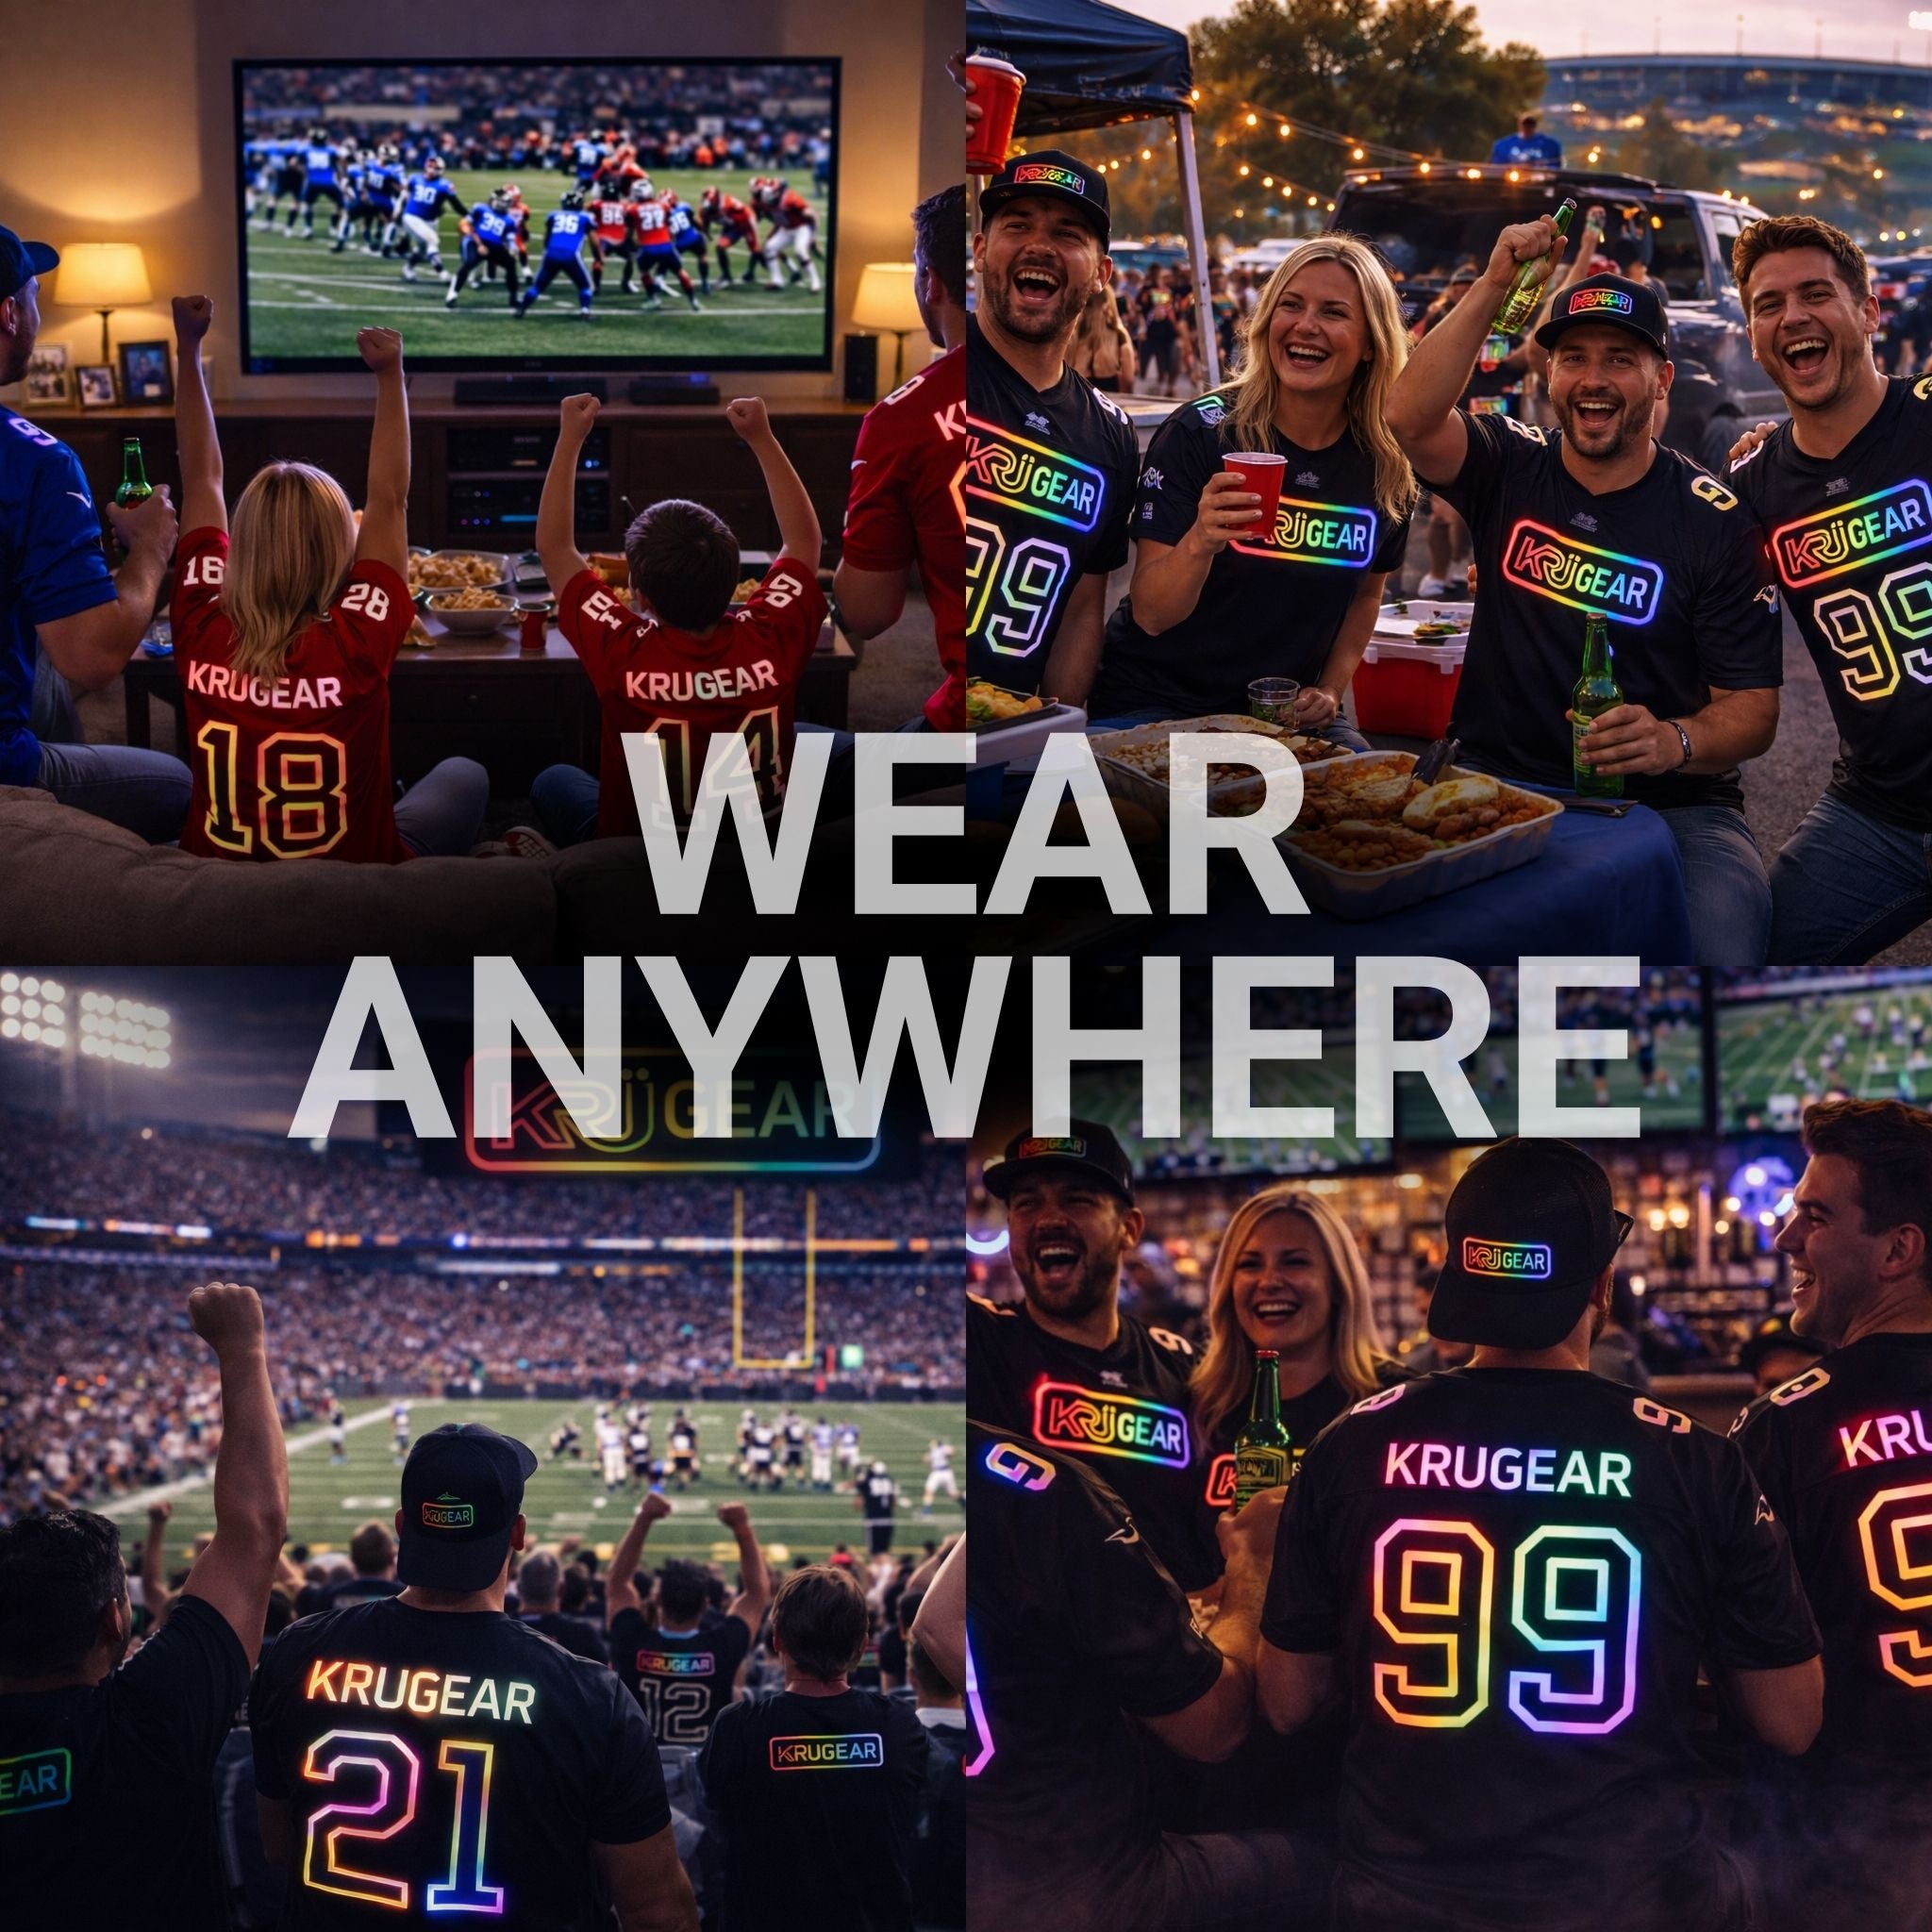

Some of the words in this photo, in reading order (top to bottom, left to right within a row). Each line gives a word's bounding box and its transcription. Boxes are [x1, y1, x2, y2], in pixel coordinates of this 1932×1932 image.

[341, 583, 390, 622] 28
[188, 659, 343, 708] KRUGEAR
[625, 658, 779, 702] KRUGEAR
[197, 720, 348, 859] 18
[643, 705, 787, 832] 14
[1384, 1441, 1633, 1498] KRUGEAR
[1373, 1518, 1642, 1734] 99
[307, 1660, 537, 1724] KRUGEAR
[641, 1657, 710, 1673] KRUGEAR
[639, 1678, 712, 1743] 12
[777, 1741, 877, 1762] KRUGEAR
[304, 1728, 505, 1915] 21
